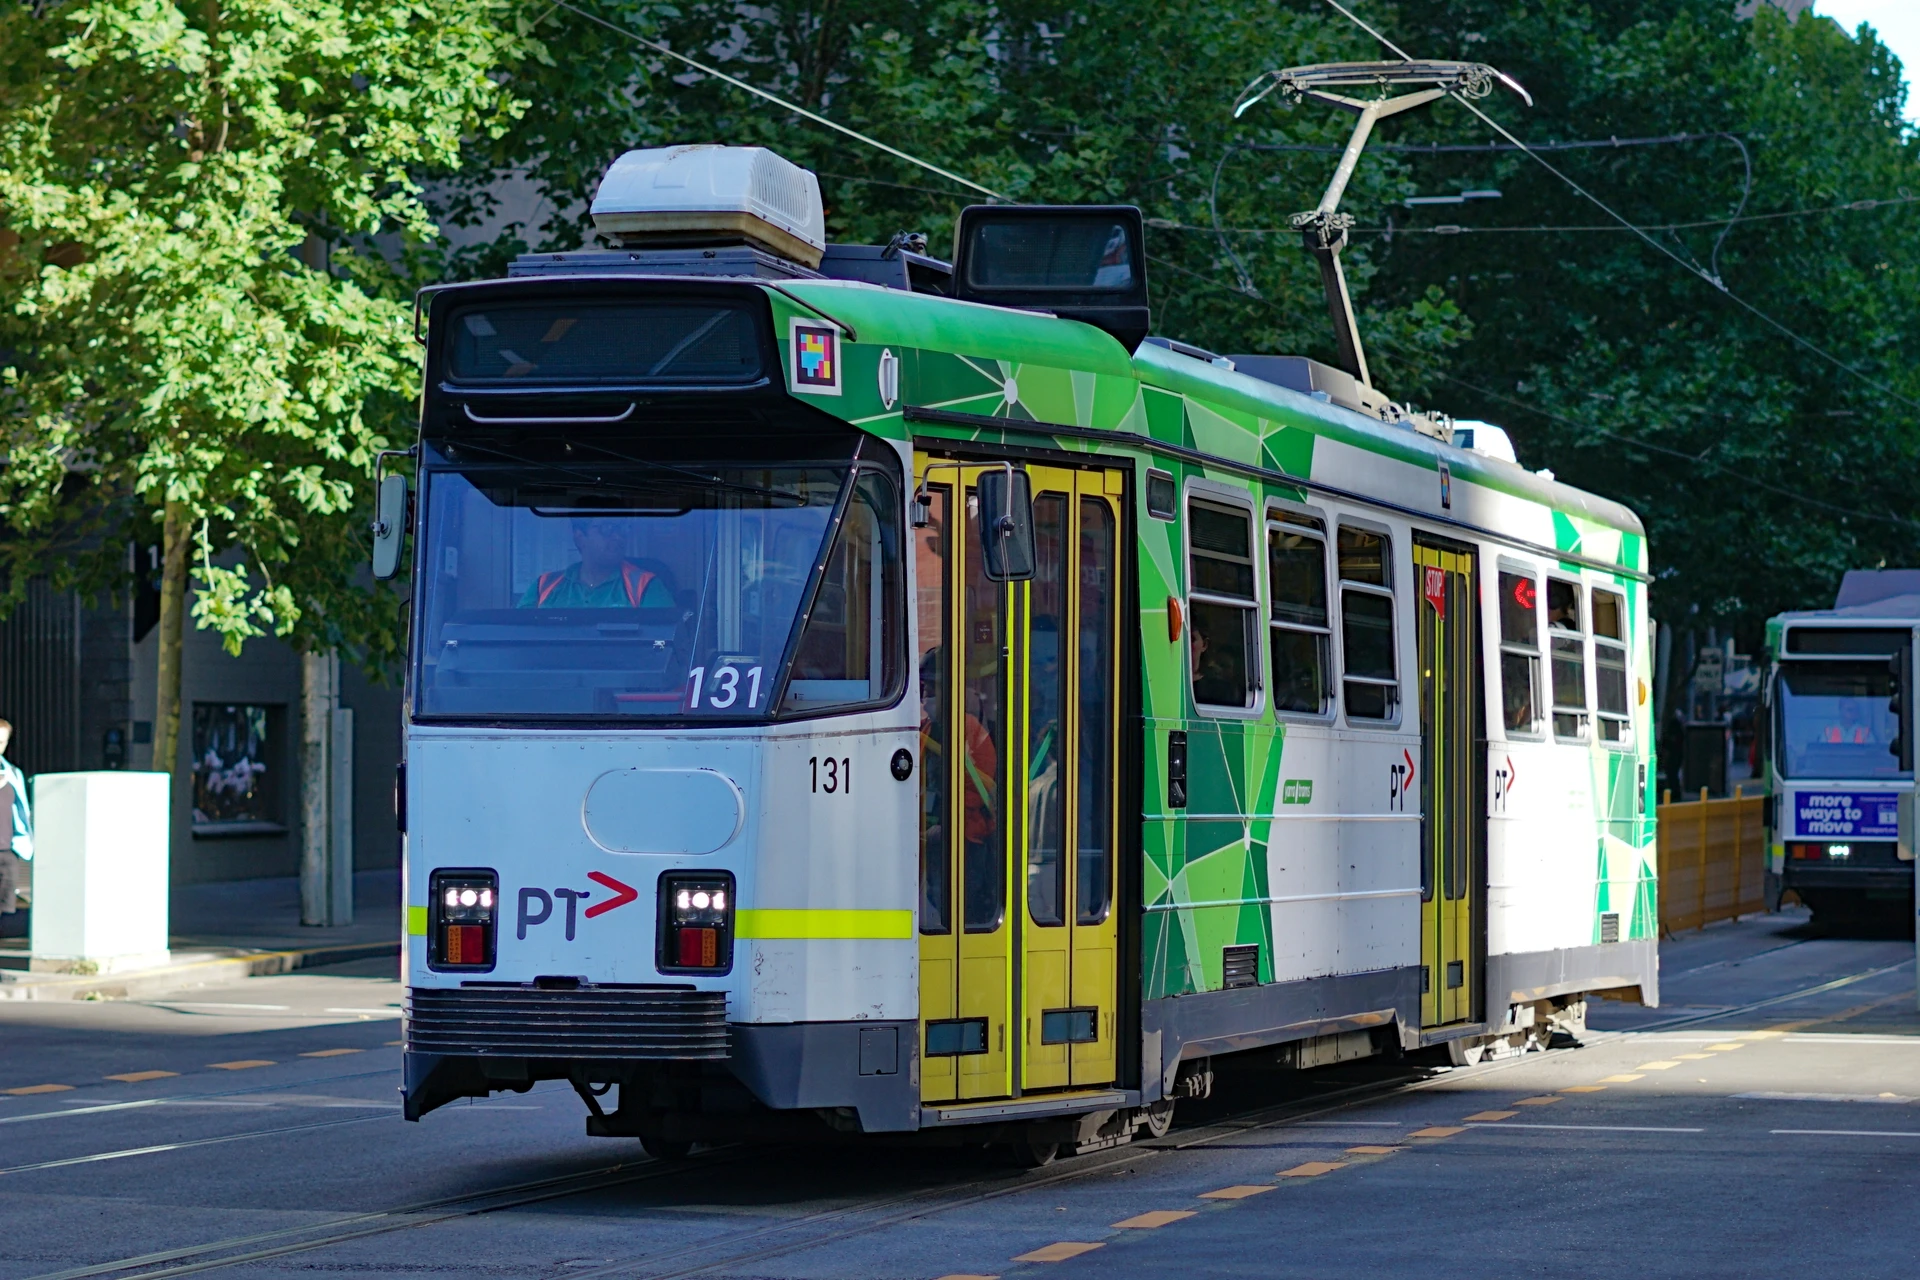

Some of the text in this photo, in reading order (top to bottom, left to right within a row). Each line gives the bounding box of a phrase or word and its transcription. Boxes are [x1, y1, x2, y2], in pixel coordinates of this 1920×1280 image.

[1426, 569, 1442, 597] STOP
[689, 666, 763, 709] 131
[809, 756, 850, 794] 131
[1809, 795, 1853, 808] more
[1800, 807, 1862, 822] ways to
[1808, 821, 1853, 833] move
